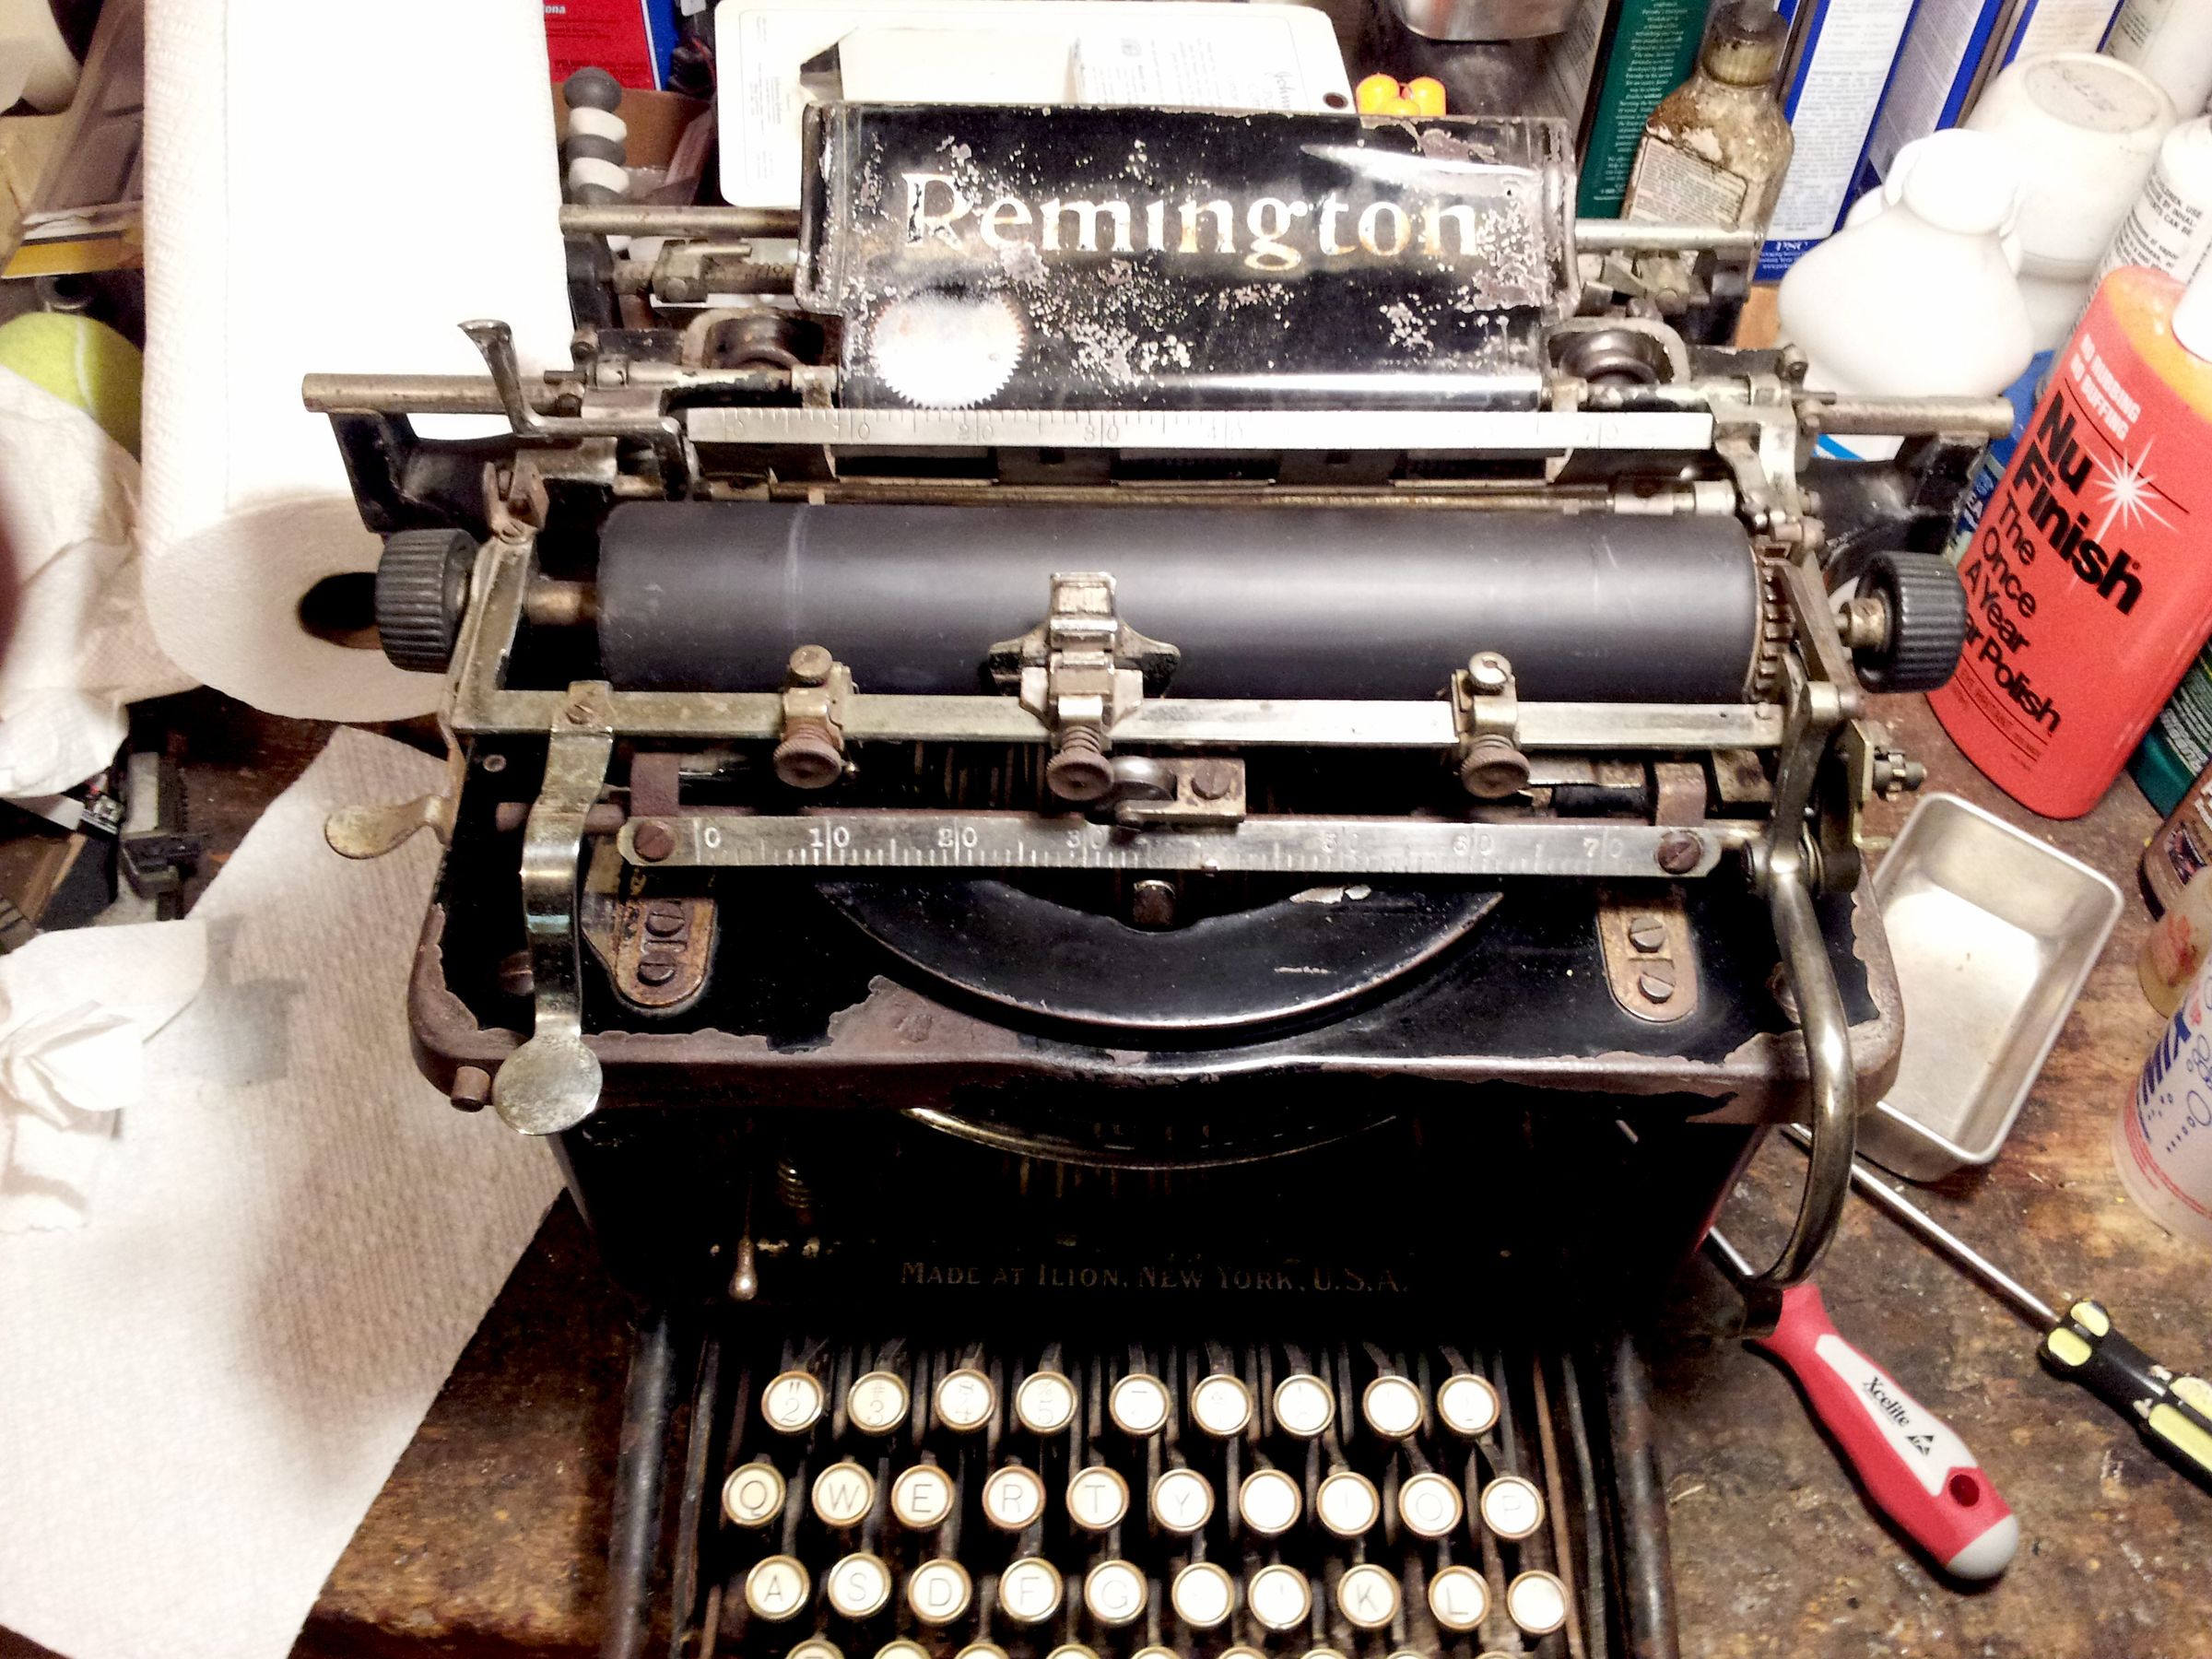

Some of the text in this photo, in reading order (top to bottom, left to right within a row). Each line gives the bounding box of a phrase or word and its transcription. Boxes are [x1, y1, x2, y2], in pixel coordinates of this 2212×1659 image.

[901, 171, 1477, 272] Remington
[2090, 354, 2141, 424] RUBBING
[2080, 373, 2129, 441] BUFFING
[2037, 391, 2093, 496] Nu
[1999, 490, 2036, 566] The
[2013, 440, 2143, 616] Finish
[1983, 526, 2036, 618] Once
[1965, 559, 1983, 596] A
[1980, 574, 2031, 653] Year
[1965, 611, 1984, 646] ar
[1978, 635, 2062, 734] Polish
[705, 826, 722, 849] 0
[809, 827, 851, 849] 10
[937, 827, 979, 849] 20
[1453, 832, 1495, 857] 60
[1583, 836, 1624, 860] 70
[901, 1261, 981, 1285] MADE
[993, 1266, 1024, 1286] AT
[1139, 1265, 1204, 1288] NEW
[781, 1397, 803, 1423] 2
[866, 1398, 887, 1426] 3
[1862, 1376, 1910, 1427] Xcelite
[828, 1482, 861, 1514] W
[910, 1483, 934, 1514] E
[1001, 1483, 1024, 1514] R
[1083, 1484, 1107, 1514] T
[1174, 1489, 1193, 1518] Y
[1415, 1491, 1444, 1522] O
[1502, 1494, 1524, 1523] P
[762, 1573, 785, 1604] A
[846, 1571, 868, 1603] S
[927, 1578, 954, 1607] D
[1018, 1576, 1041, 1606] F
[1100, 1579, 1129, 1610] G
[1356, 1583, 1380, 1613] K
[1443, 1583, 1471, 1616] L
